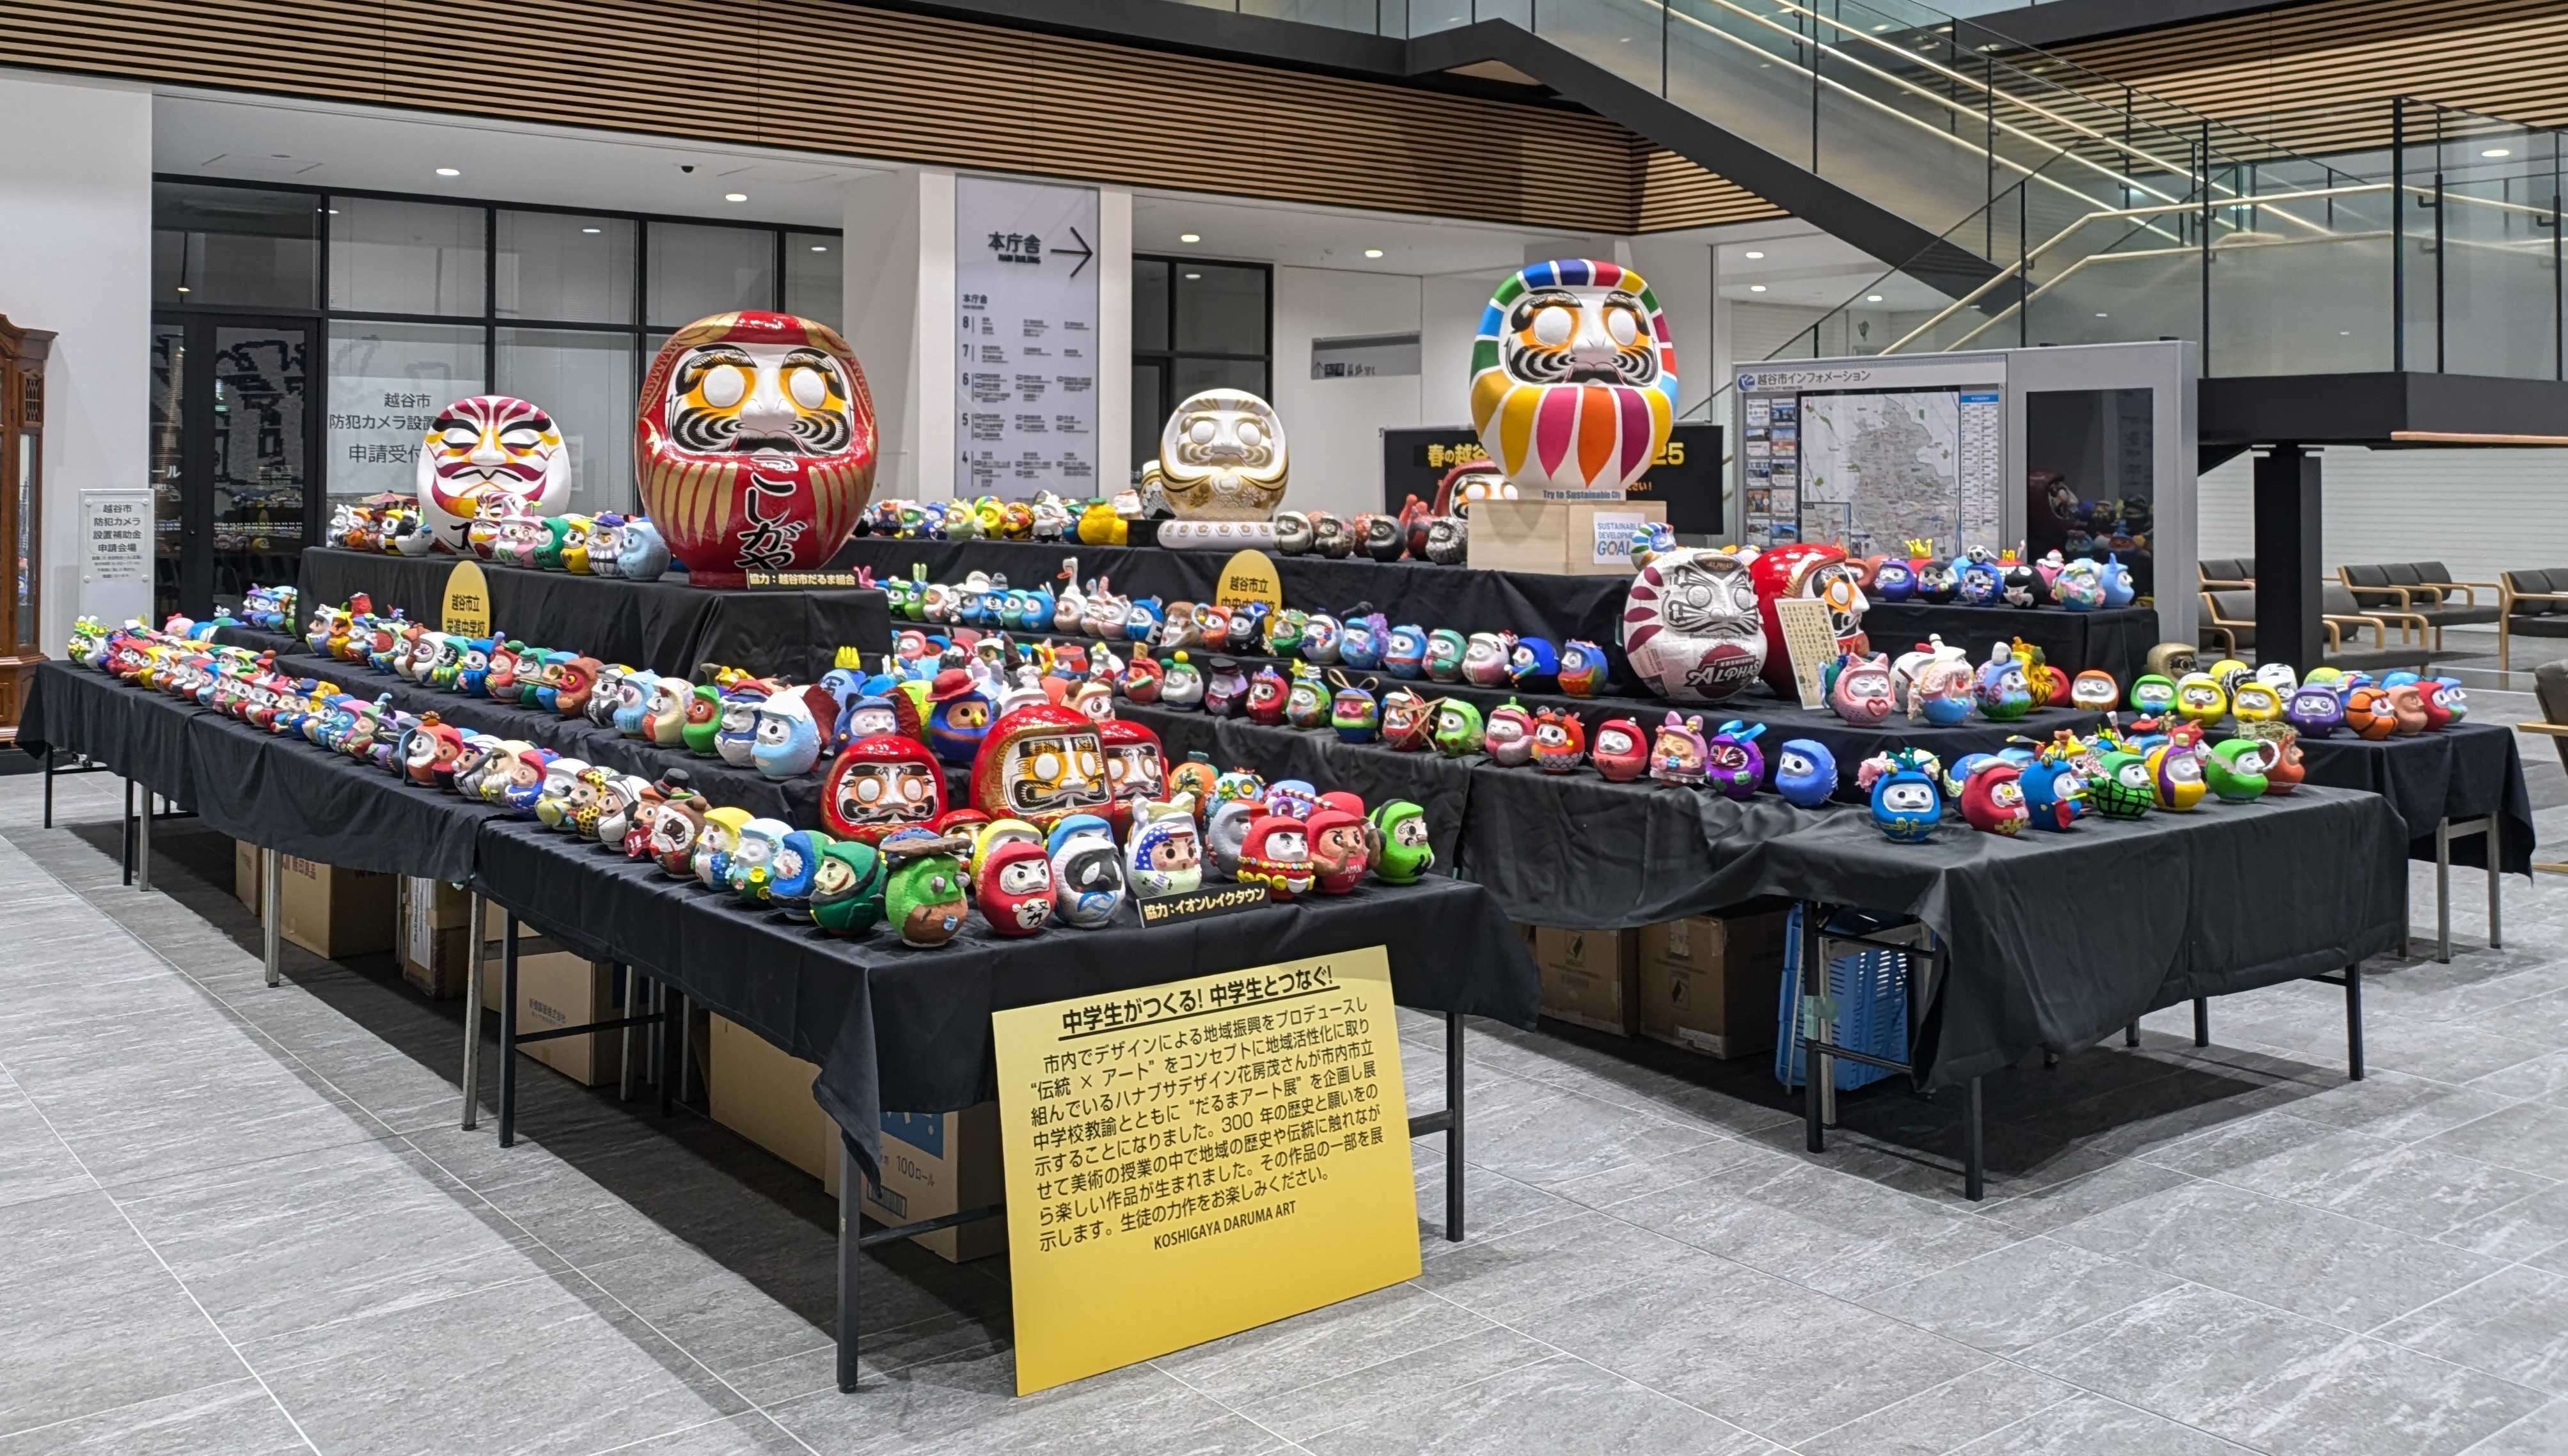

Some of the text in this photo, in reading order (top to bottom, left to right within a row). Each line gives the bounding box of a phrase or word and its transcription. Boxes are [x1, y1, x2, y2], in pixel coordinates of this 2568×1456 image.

[988, 231, 1041, 254] 本庁舎
[963, 294, 988, 304] 本庁舎
[963, 315, 969, 329] 8
[963, 344, 969, 357] 7
[963, 372, 969, 386] 6
[1758, 370, 1871, 386] 越谷市インフォメーション
[383, 392, 432, 409] 越谷市
[329, 414, 437, 431] 防犯カメラ設置
[963, 412, 968, 427] 5
[962, 450, 968, 464] 4
[1543, 490, 1554, 499] Try
[1556, 490, 1564, 499] to
[1566, 490, 1611, 499] Sustainable
[102, 504, 132, 513] 越谷市
[734, 456, 808, 571] こしがや
[93, 517, 141, 527] 防犯カメラ
[93, 530, 142, 540] 設置補助金
[97, 543, 137, 552] 申請会場
[1229, 575, 1269, 594] 越谷市立
[451, 593, 480, 612] 越谷市立
[1688, 660, 1761, 685] ALPHAS
[1144, 888, 1266, 921] 協力：イオンレイクタウン
[1062, 965, 1334, 1035] 中学生がつくる! 中学生とつなぐ!
[1043, 996, 1368, 1074] 市内でデザインによる地域振興をプロデュースし
[1030, 1038, 1375, 1128] 組んでいるハナブサデザイン花房茂さんが市内市立
[1036, 1103, 1382, 1201] せて美術の授業の中で地域の歴史や伝統に触れなが
[897, 1155, 935, 1187] 100ロール
[1153, 1200, 1296, 1250] KOSHIGAYA DARUMA ART
